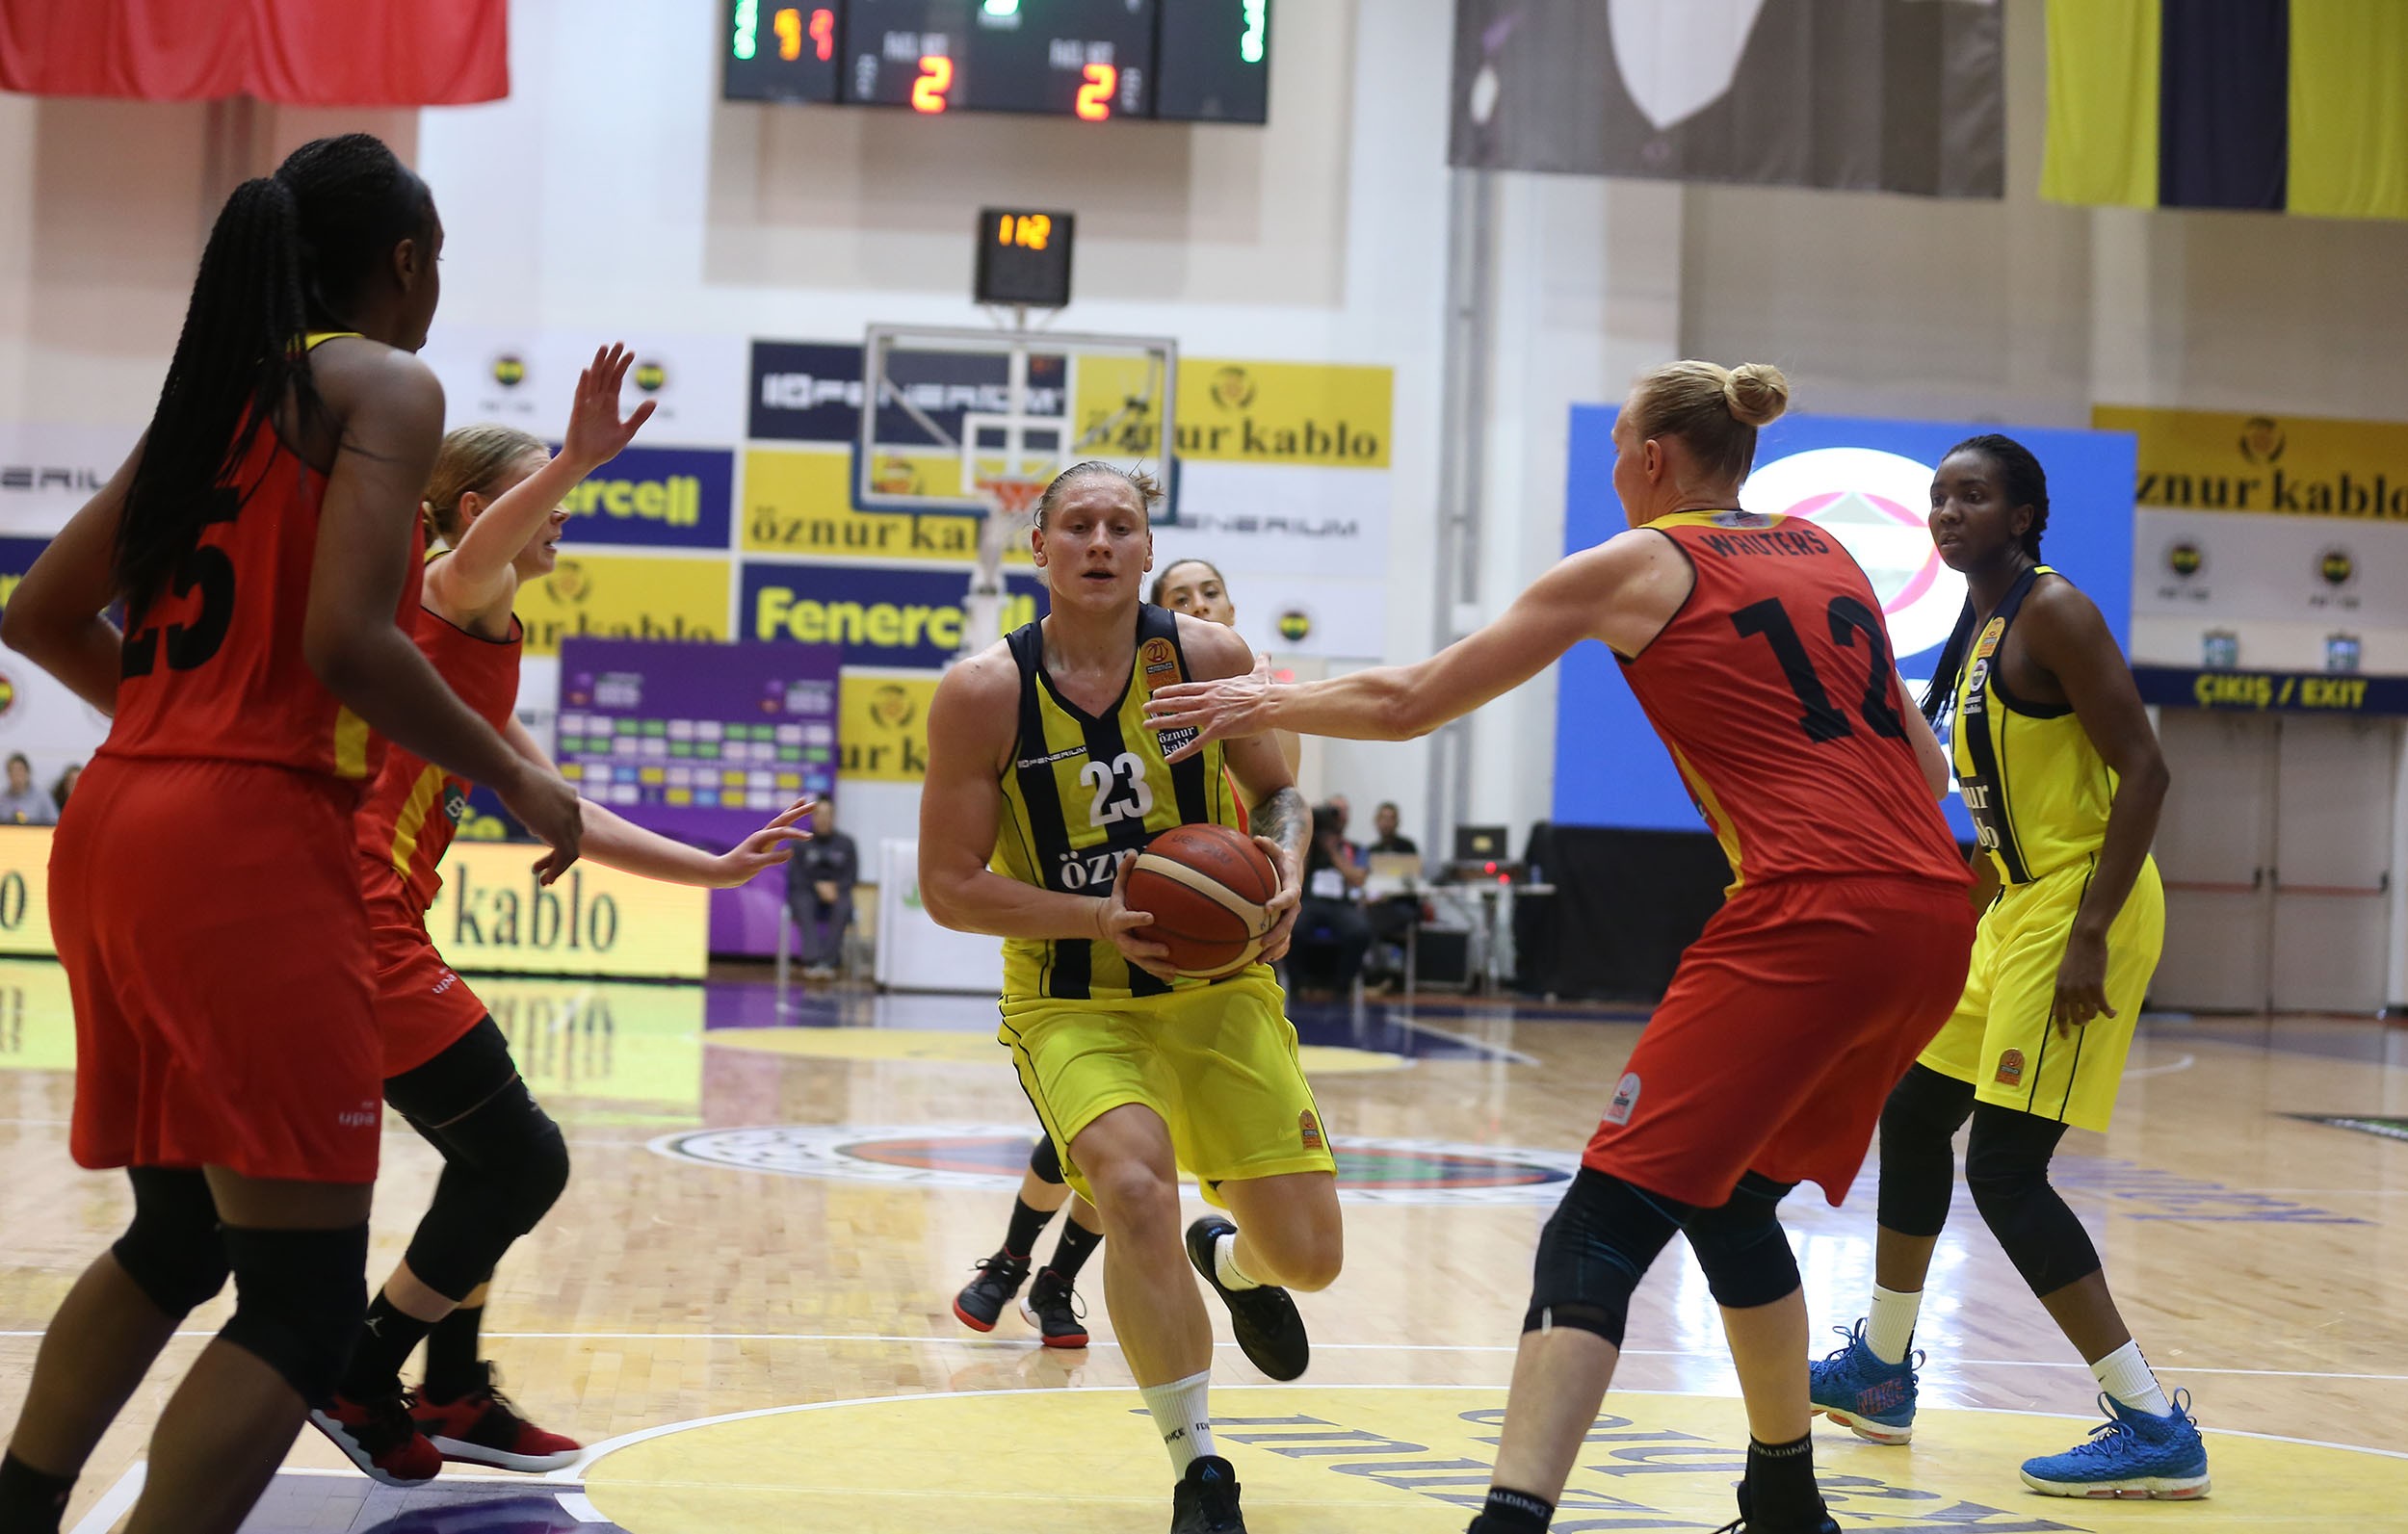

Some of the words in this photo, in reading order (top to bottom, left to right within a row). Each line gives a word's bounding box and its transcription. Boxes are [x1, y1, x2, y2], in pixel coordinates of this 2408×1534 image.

[911, 55, 954, 114] 2
[1075, 63, 1117, 121] 2
[1242, 418, 1377, 458] kablo
[2135, 473, 2262, 508] znur
[752, 506, 901, 549] öznur
[1699, 529, 1830, 559] WAUTERS
[756, 586, 1036, 650] Fenercll
[1730, 595, 1912, 745] 12
[2300, 679, 2367, 709] EXIT
[1159, 726, 1195, 744] öznur
[1080, 752, 1153, 828] 23
[453, 862, 619, 952] kablo
